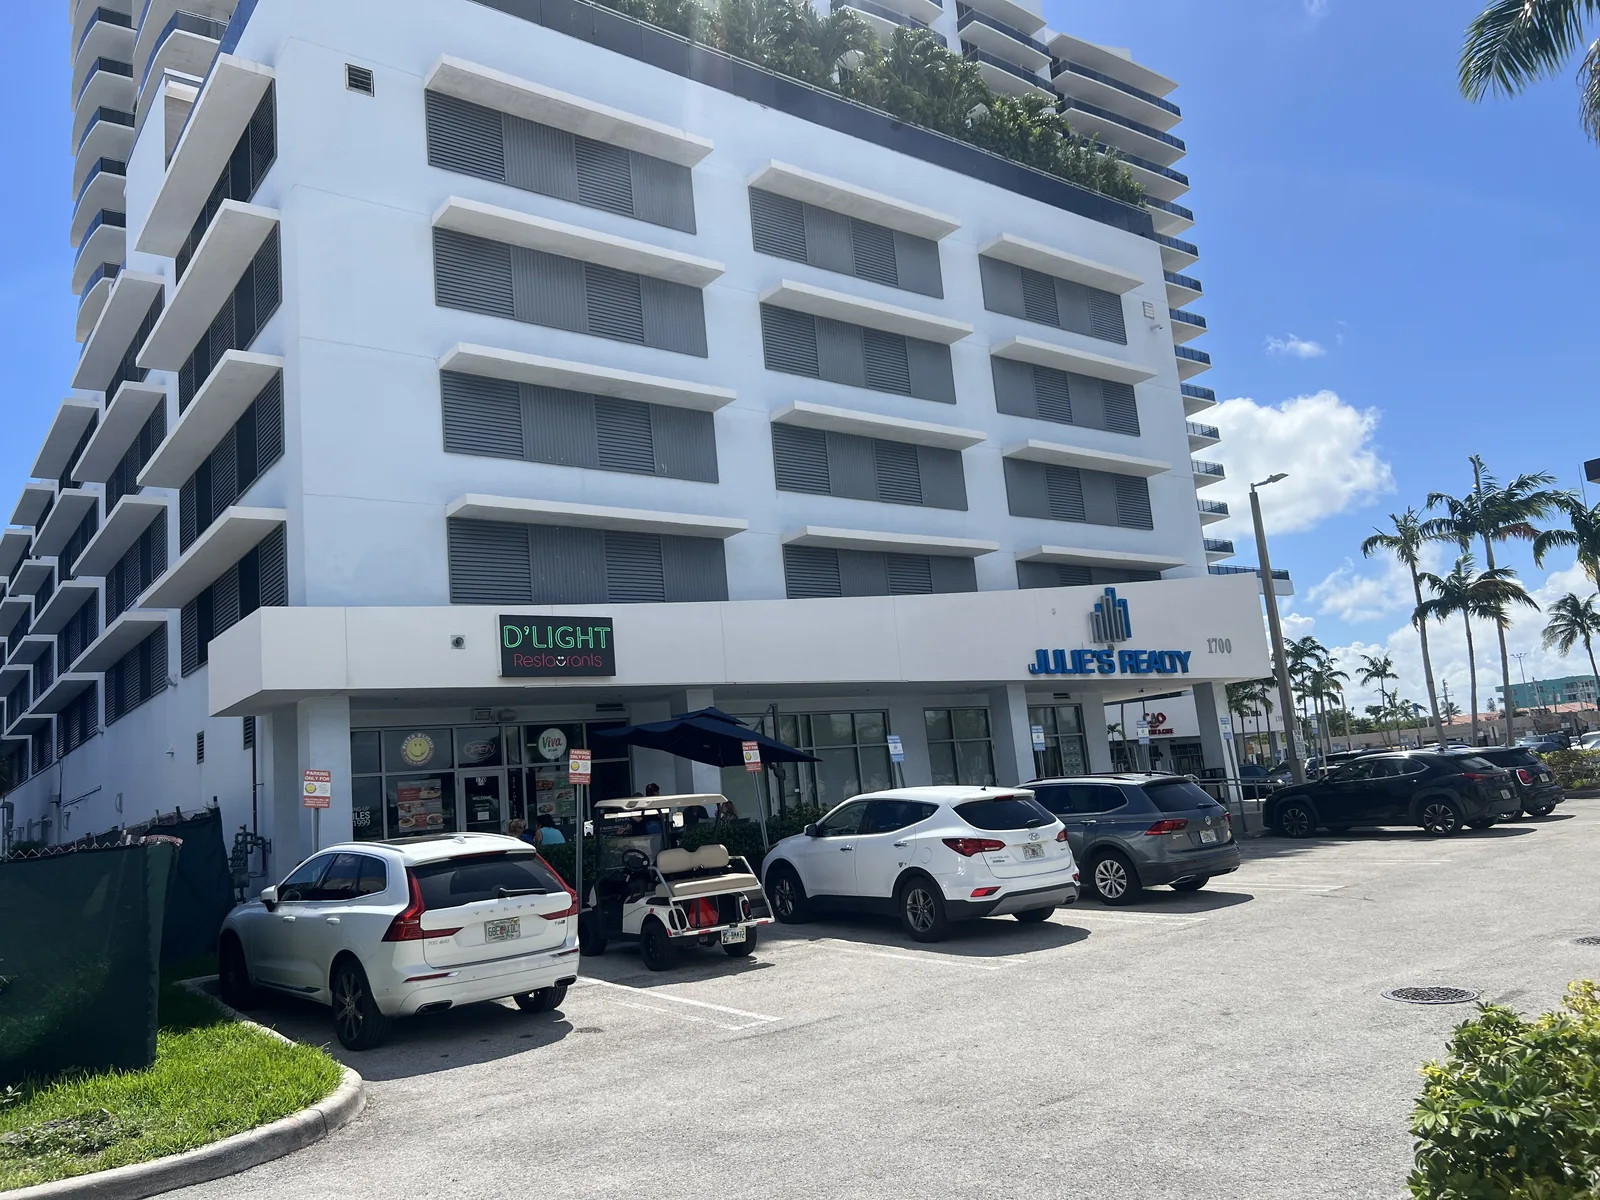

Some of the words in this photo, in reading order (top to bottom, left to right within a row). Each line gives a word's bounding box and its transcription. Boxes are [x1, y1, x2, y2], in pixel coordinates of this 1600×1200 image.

[503, 625, 611, 649] D'LIGHT
[1207, 637, 1232, 654] 1700
[1028, 648, 1116, 675] JULIE'S
[1118, 649, 1192, 674] REALTY
[465, 744, 496, 754] OPEN
[542, 736, 563, 749] Viva
